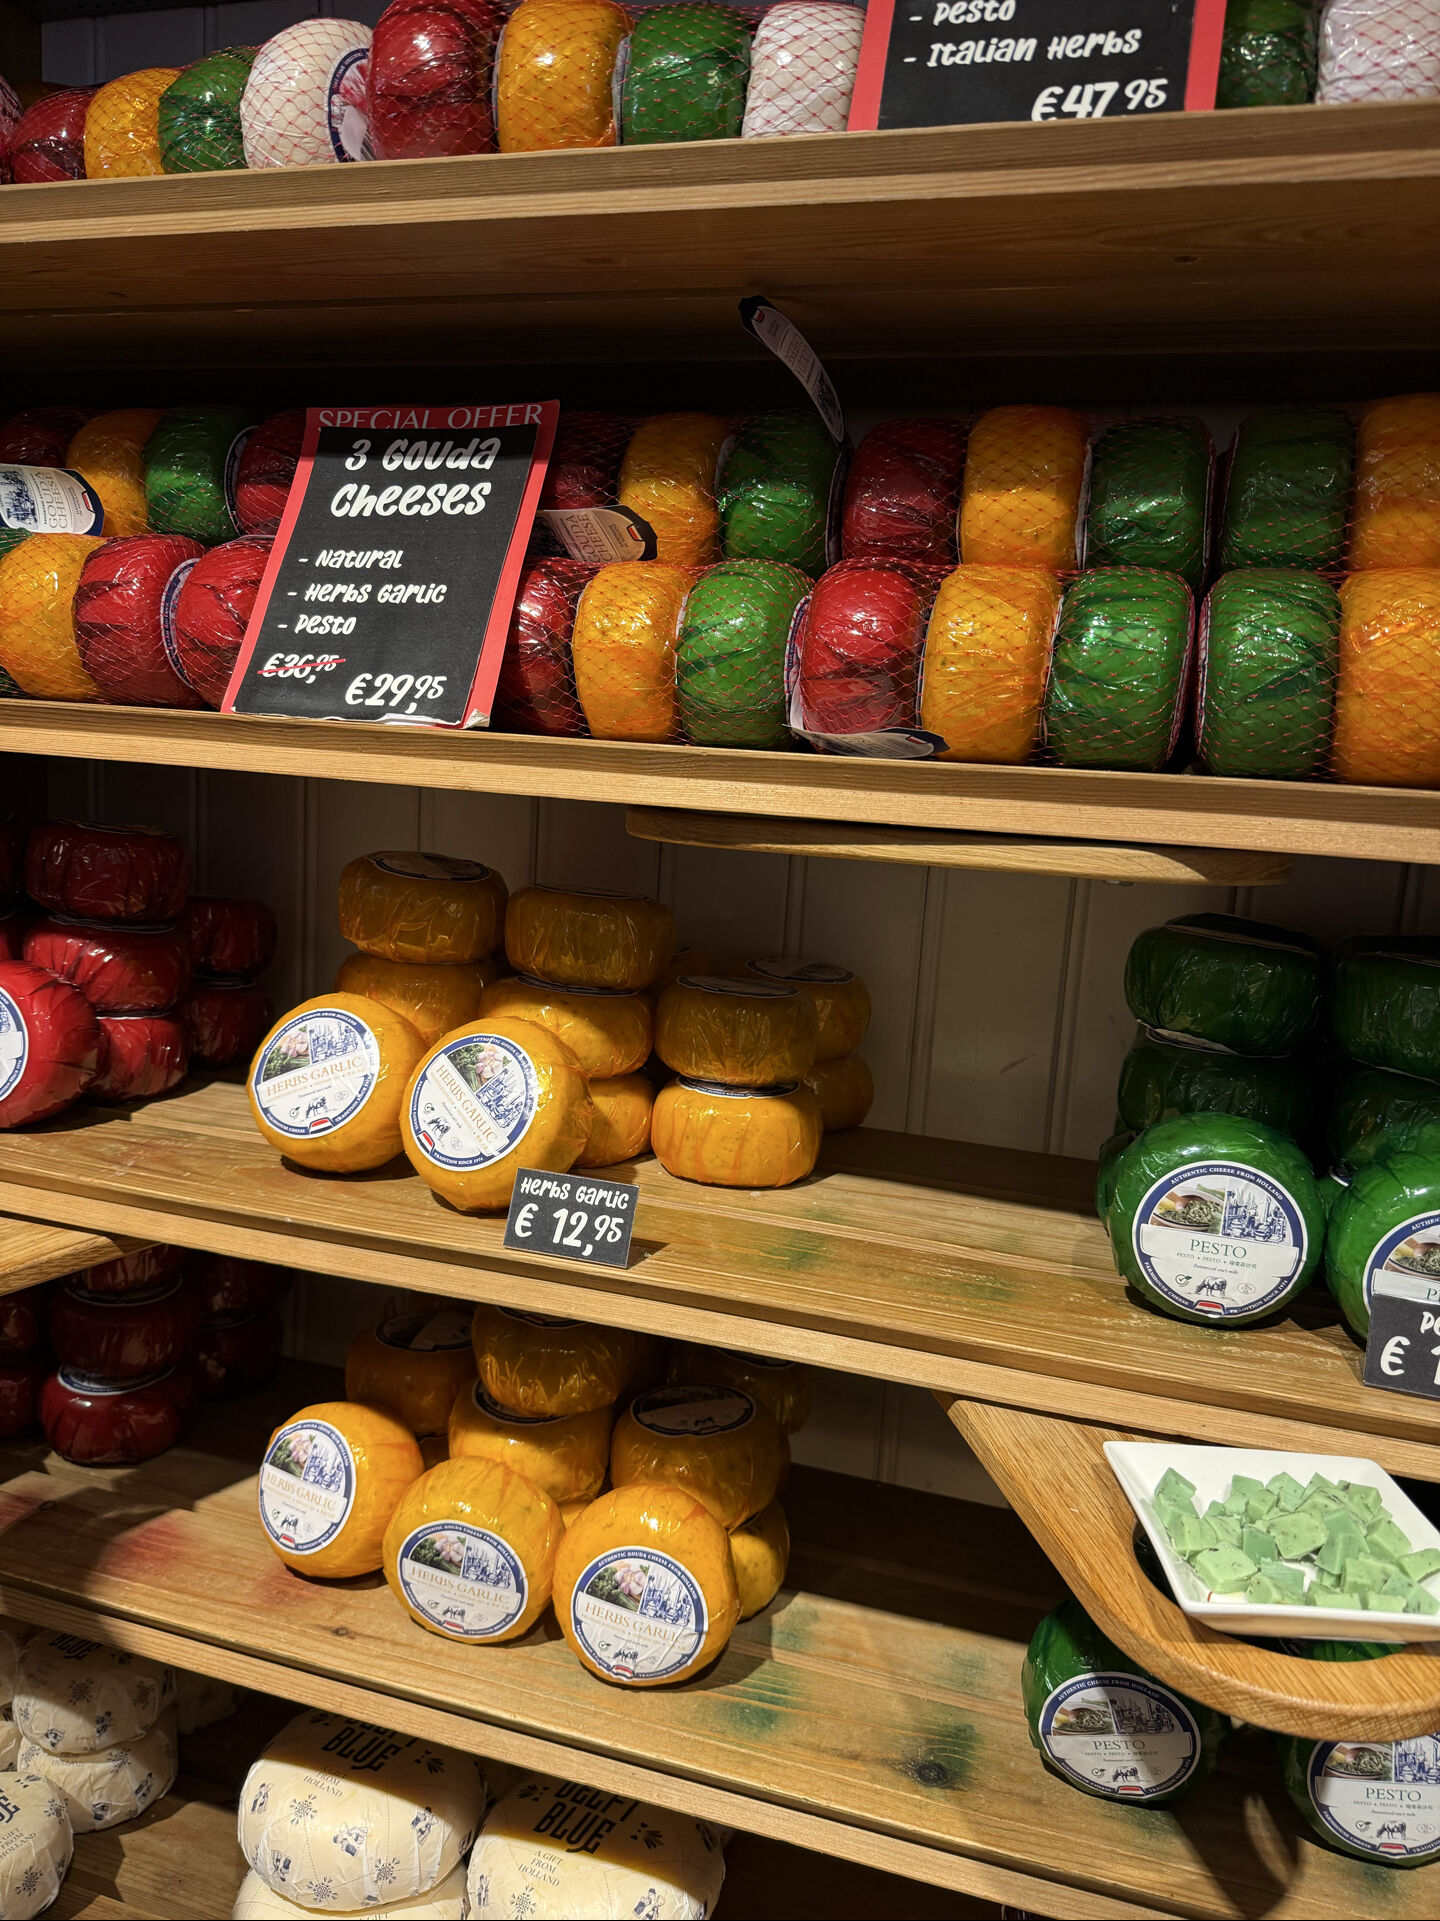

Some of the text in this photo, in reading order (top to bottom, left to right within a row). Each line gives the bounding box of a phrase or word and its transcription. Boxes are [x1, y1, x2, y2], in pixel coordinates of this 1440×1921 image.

[926, 38, 1036, 67] Italian
[1047, 29, 1142, 60] Herbs
[447, 404, 542, 429] OFFER
[345, 437, 500, 471] 3 Gouda
[34, 472, 58, 528] GOUDA
[42, 472, 68, 528] CHEESE
[330, 482, 492, 517] Cheeses
[566, 514, 600, 562] GOUDA
[579, 514, 612, 561] CHEESE
[315, 549, 403, 569] Natural
[304, 583, 372, 603] Herbs
[378, 583, 447, 604] Garlic
[344, 673, 448, 714] €29,95
[266, 1074, 308, 1096] HERBS
[310, 1056, 363, 1080] GARLIC
[436, 1064, 466, 1102] HERBS
[462, 1099, 498, 1144] GARLIC
[520, 1177, 630, 1210] Herbs Garlic
[1171, 1167, 1208, 1184] AUTHENTIC
[1236, 1170, 1256, 1180] FROM
[1256, 1178, 1283, 1200] HOLLAND
[514, 1203, 624, 1256] € 12,95
[1190, 1239, 1246, 1258] PESTO
[1144, 1261, 1188, 1306] FARMHOUSE CHEESE
[1230, 1301, 1262, 1314] TRADITION
[1263, 1290, 1279, 1302] SINCE
[1380, 1336, 1410, 1376] €
[266, 1472, 296, 1494] HERBS
[296, 1486, 336, 1510] GARLIC
[411, 1566, 454, 1588] HERBS
[457, 1583, 510, 1602] GARLIC
[598, 1551, 626, 1567] AUTHENTIC
[648, 1552, 668, 1566] CHEESE
[668, 1562, 682, 1576] FROM
[681, 1574, 698, 1599] HOLLAND
[585, 1602, 630, 1628] HERBS
[633, 1620, 679, 1642] GARLI
[1058, 1682, 1086, 1700] AUTHENTIC
[1131, 1683, 1160, 1698] HOLLAND
[322, 1728, 401, 1772] BLUE
[1094, 1740, 1146, 1750] PESTO
[303, 1776, 342, 1798] HOLLAND
[316, 1772, 341, 1786] FROM
[1366, 1788, 1422, 1802] PESTO
[1, 1832, 24, 1850] FROM
[534, 1802, 617, 1854] BLUE
[518, 1864, 560, 1887] HOLLAND
[530, 1858, 558, 1874] FROM
[542, 1852, 564, 1866] GIFT
